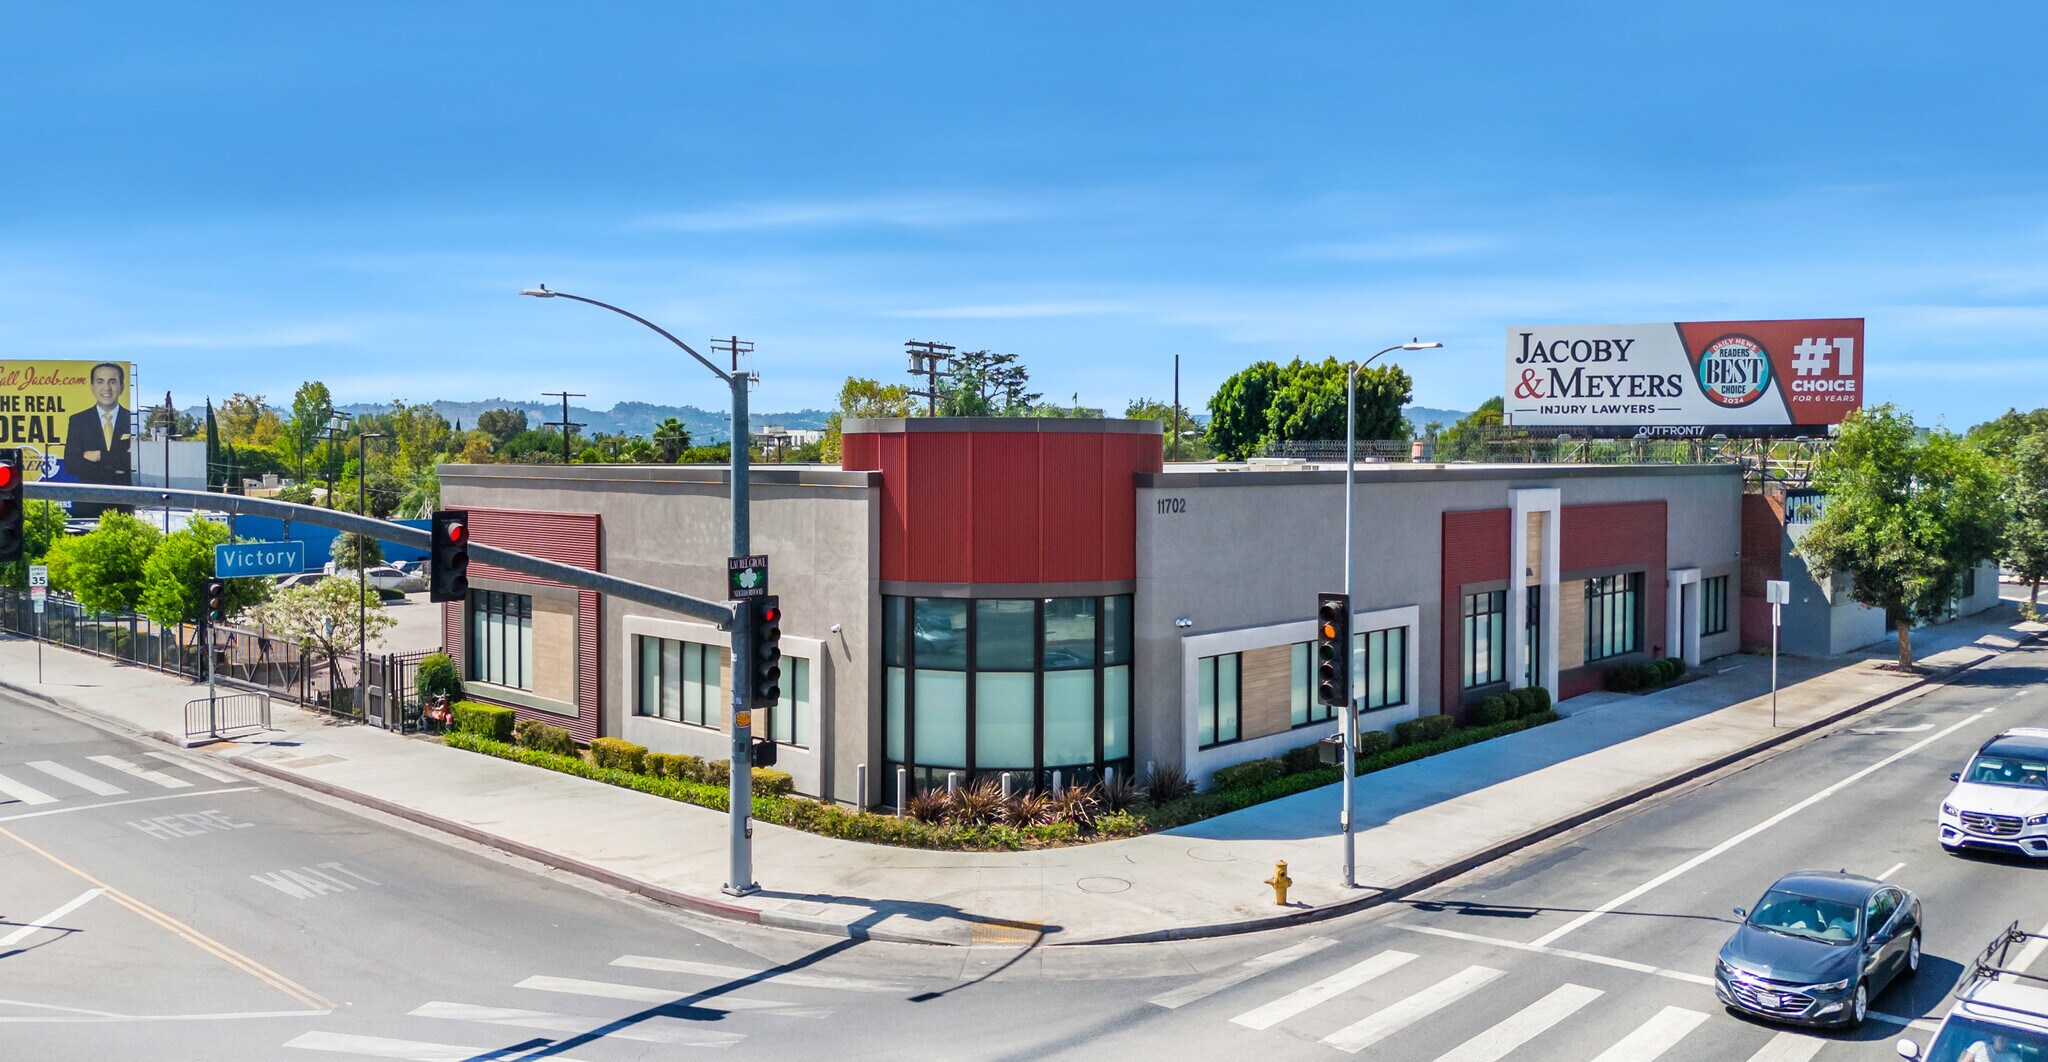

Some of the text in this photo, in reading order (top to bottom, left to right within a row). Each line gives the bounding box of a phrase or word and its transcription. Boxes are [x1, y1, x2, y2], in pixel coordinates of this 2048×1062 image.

[1516, 333, 1635, 364] JACOBY
[1712, 338, 1757, 351] DAILY NEWS
[1720, 348, 1750, 357] READERS
[1791, 338, 1854, 376] #1
[17, 366, 87, 391] Jacob.com
[1706, 358, 1764, 384] BEST
[1721, 385, 1746, 394] CHOICE
[1791, 380, 1856, 392] CHOICE
[25, 395, 66, 412] REAL
[1540, 404, 1655, 415] INJURY LAWYERS
[1157, 498, 1186, 514] 11702
[223, 551, 297, 568] Victory
[32, 576, 46, 585] 35
[126, 809, 256, 840] HERE
[249, 861, 382, 899] WAIT
